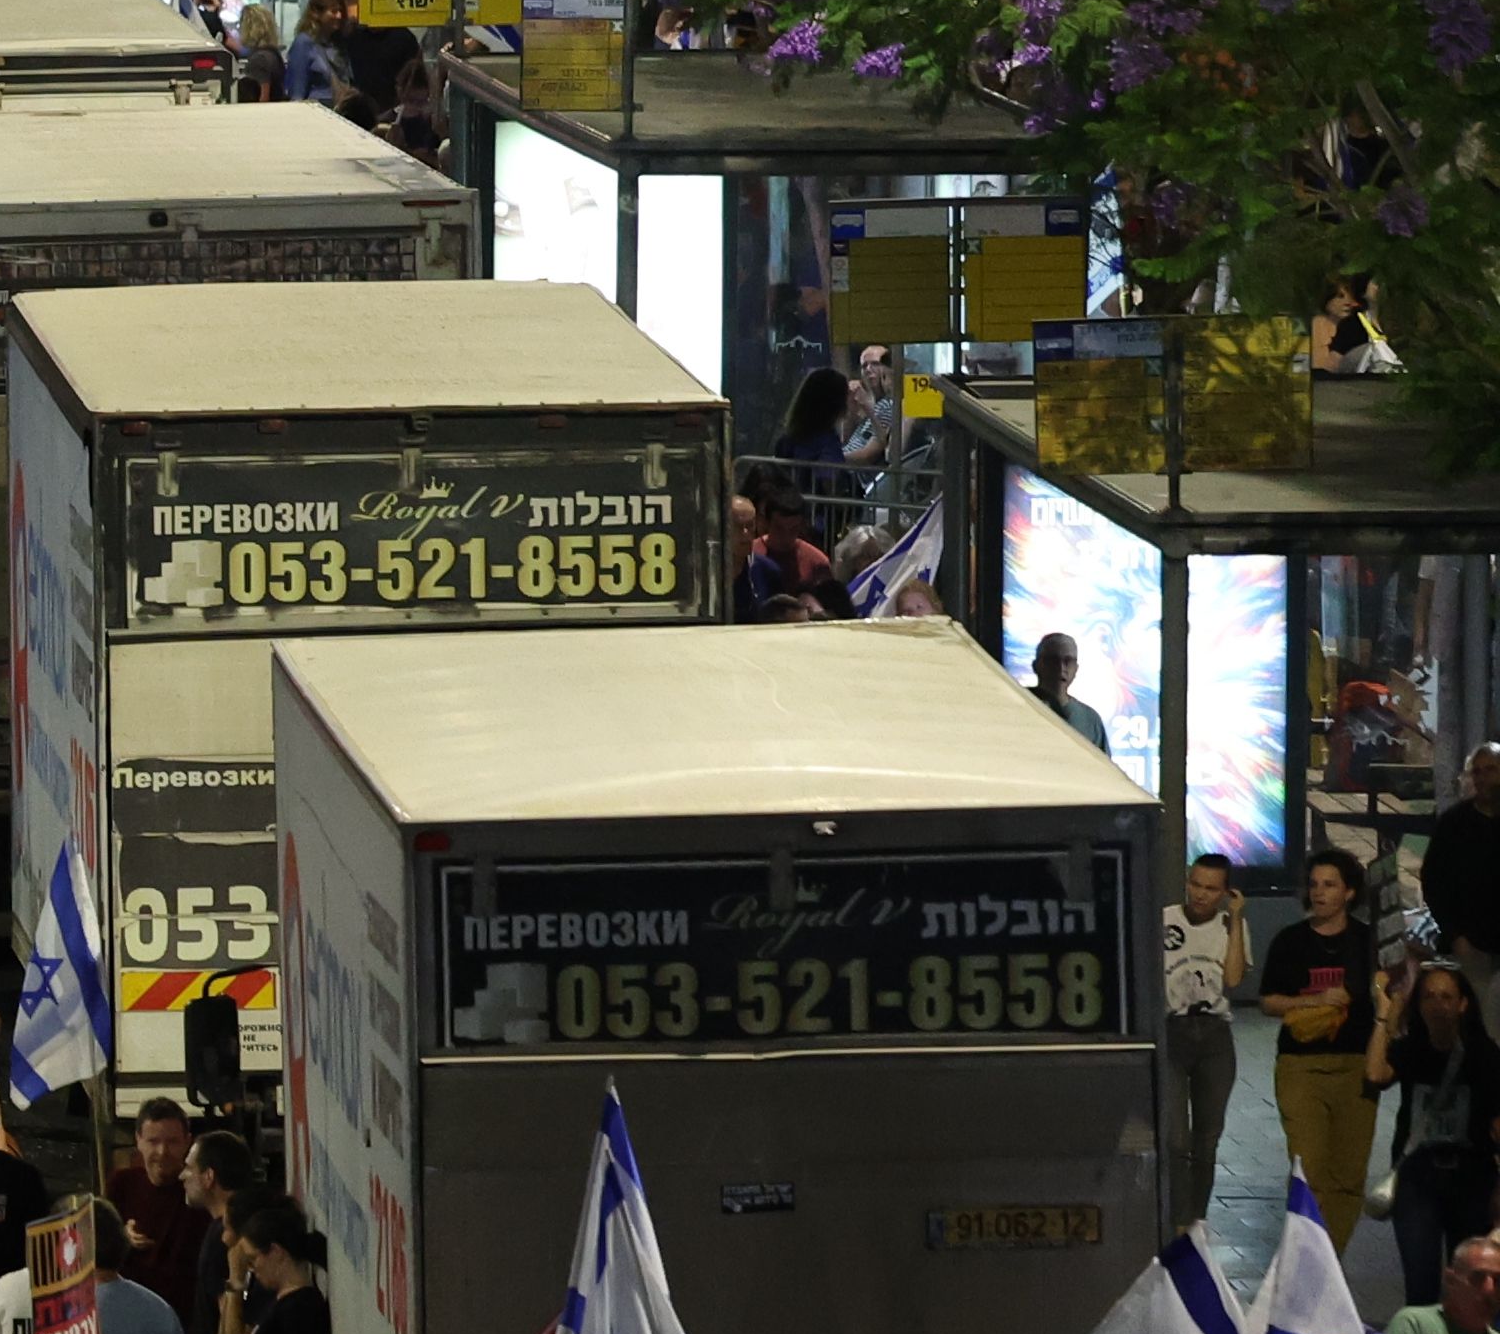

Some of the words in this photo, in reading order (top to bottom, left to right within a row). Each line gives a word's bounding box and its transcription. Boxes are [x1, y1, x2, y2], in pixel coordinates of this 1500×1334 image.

[153, 501, 339, 536] ПЕРЕВОЗКИ
[350, 484, 490, 542] Royal
[529, 493, 673, 528] הובלות
[228, 534, 677, 609] 053-521-8558
[112, 767, 275, 792] Перевозки
[123, 885, 272, 962] 053
[463, 909, 690, 951] ПЕРЕВОЗКИ
[921, 898, 1096, 939] הובלות
[555, 951, 1104, 1041] 053-521-8558
